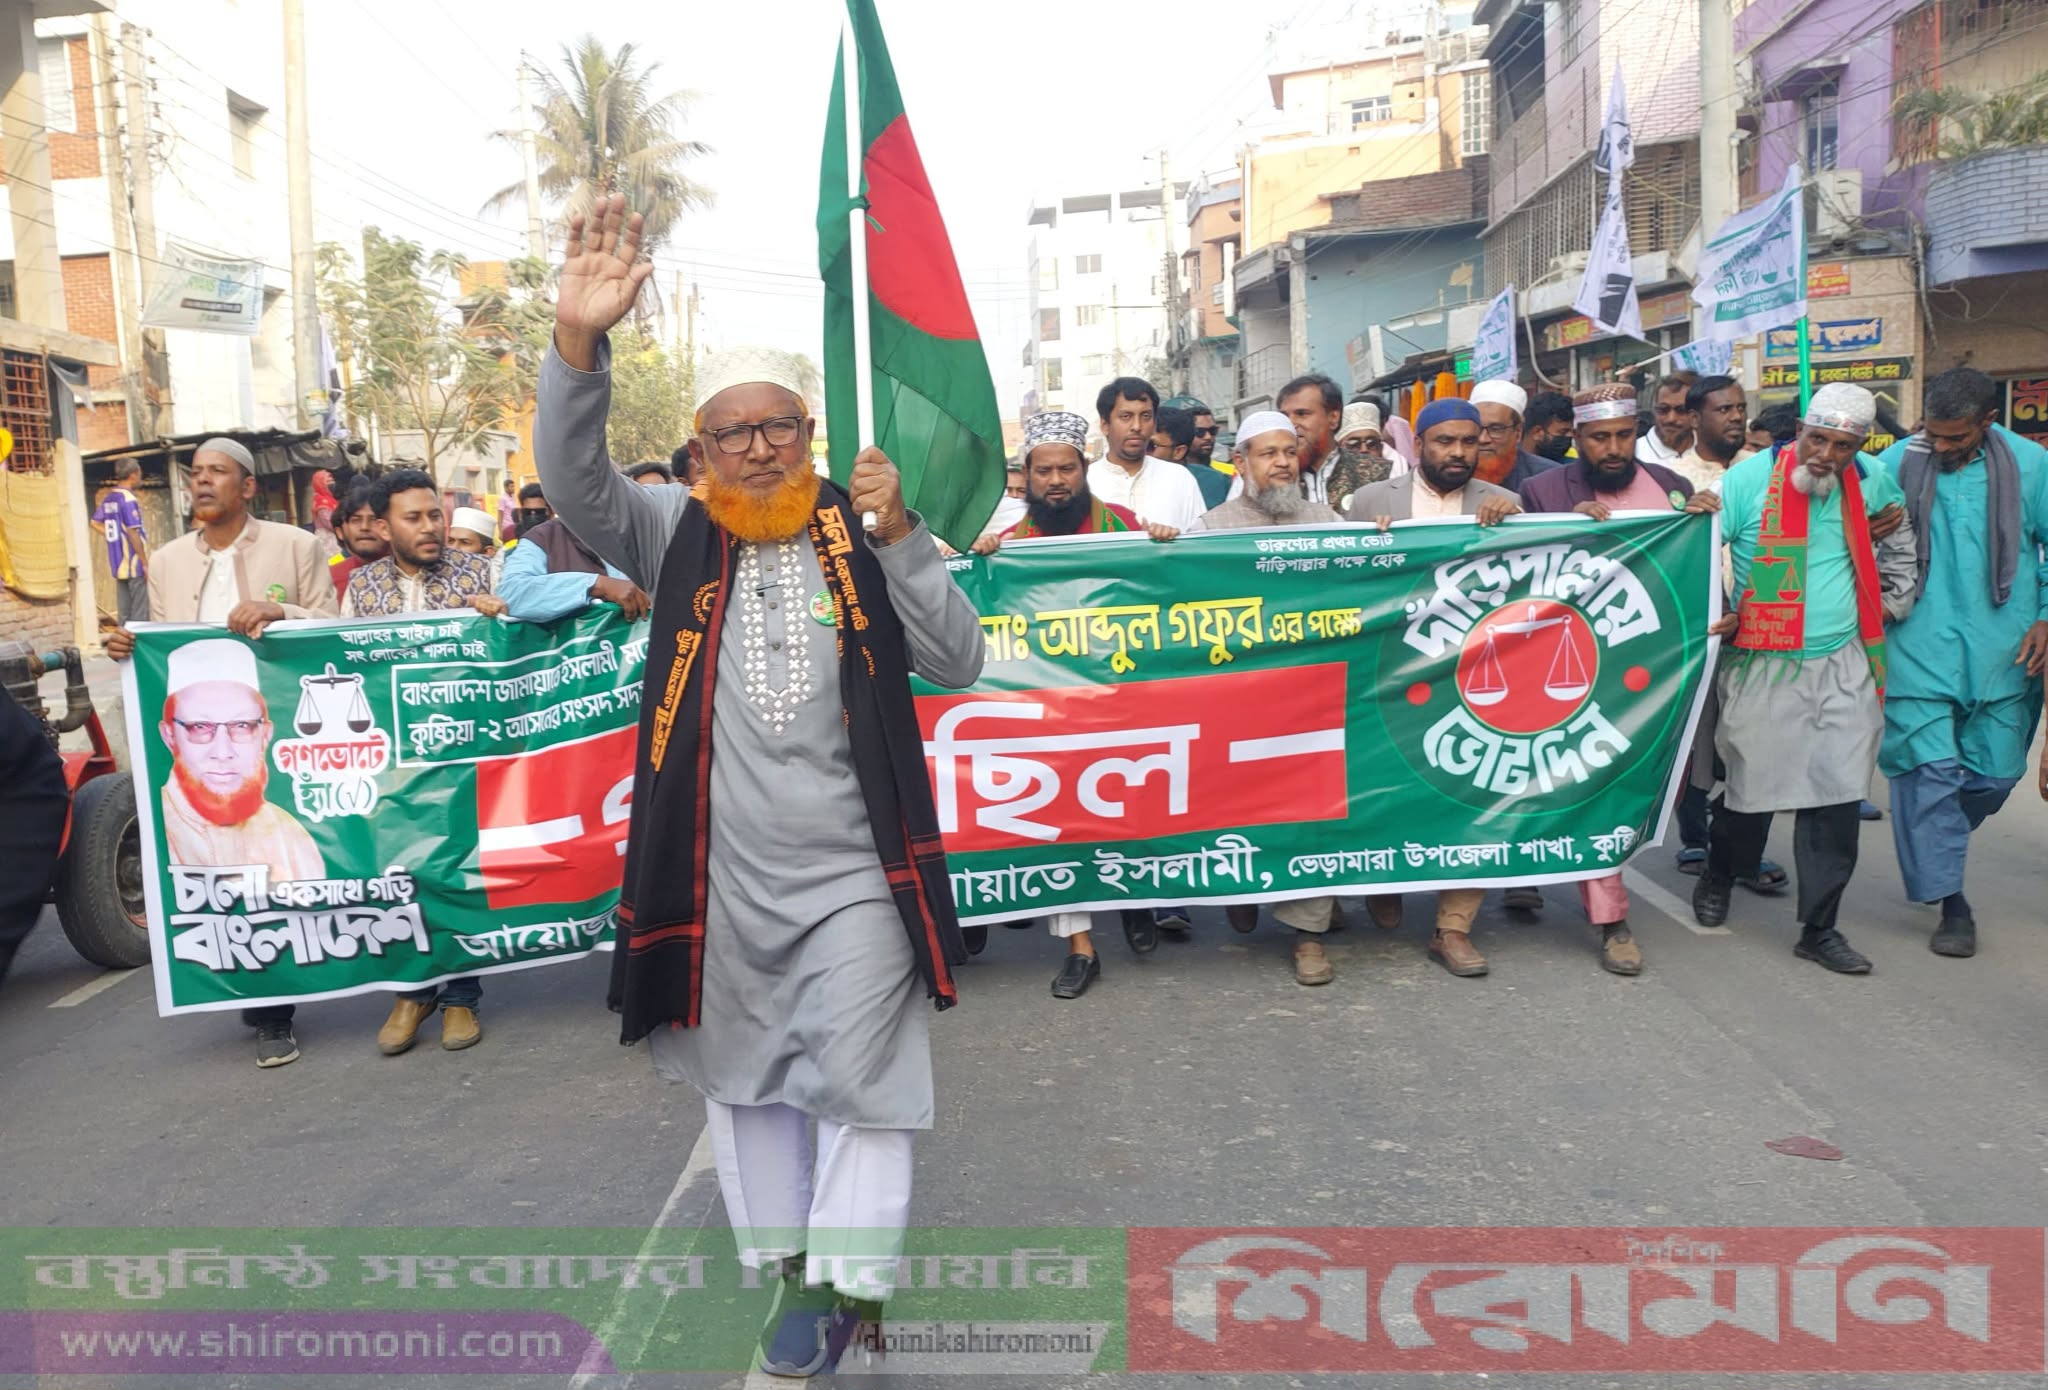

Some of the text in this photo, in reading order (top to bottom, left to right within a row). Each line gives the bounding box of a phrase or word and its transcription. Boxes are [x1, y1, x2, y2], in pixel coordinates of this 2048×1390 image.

[1254, 532, 1394, 553] তারুণ্যের প্রথম ভোট
[1333, 555, 1368, 568] পক্ষে
[1371, 552, 1407, 569] হোক
[395, 623, 435, 641] আইন
[438, 621, 464, 638] চাই
[1034, 604, 1161, 673] আব্দুল
[1169, 597, 1264, 665] গফুর
[1269, 618, 1304, 643] এর
[1307, 607, 1363, 640] পক্ষে
[369, 648, 419, 662] লোকের
[422, 643, 457, 658] শাসন
[460, 639, 487, 658] চাই
[400, 679, 491, 707] বাংলাদেশ
[407, 714, 476, 756] কুষ্টিয়া
[562, 690, 614, 723] সংসদ
[278, 735, 386, 772] গণভোটে
[1288, 848, 1398, 879] ভেড়ামারা
[1401, 841, 1511, 868] উপজেলা
[1519, 836, 1583, 863] শাখা,
[168, 864, 415, 912] চলো একসাথে গড়ি
[170, 903, 430, 971] বাংলাদেশ
